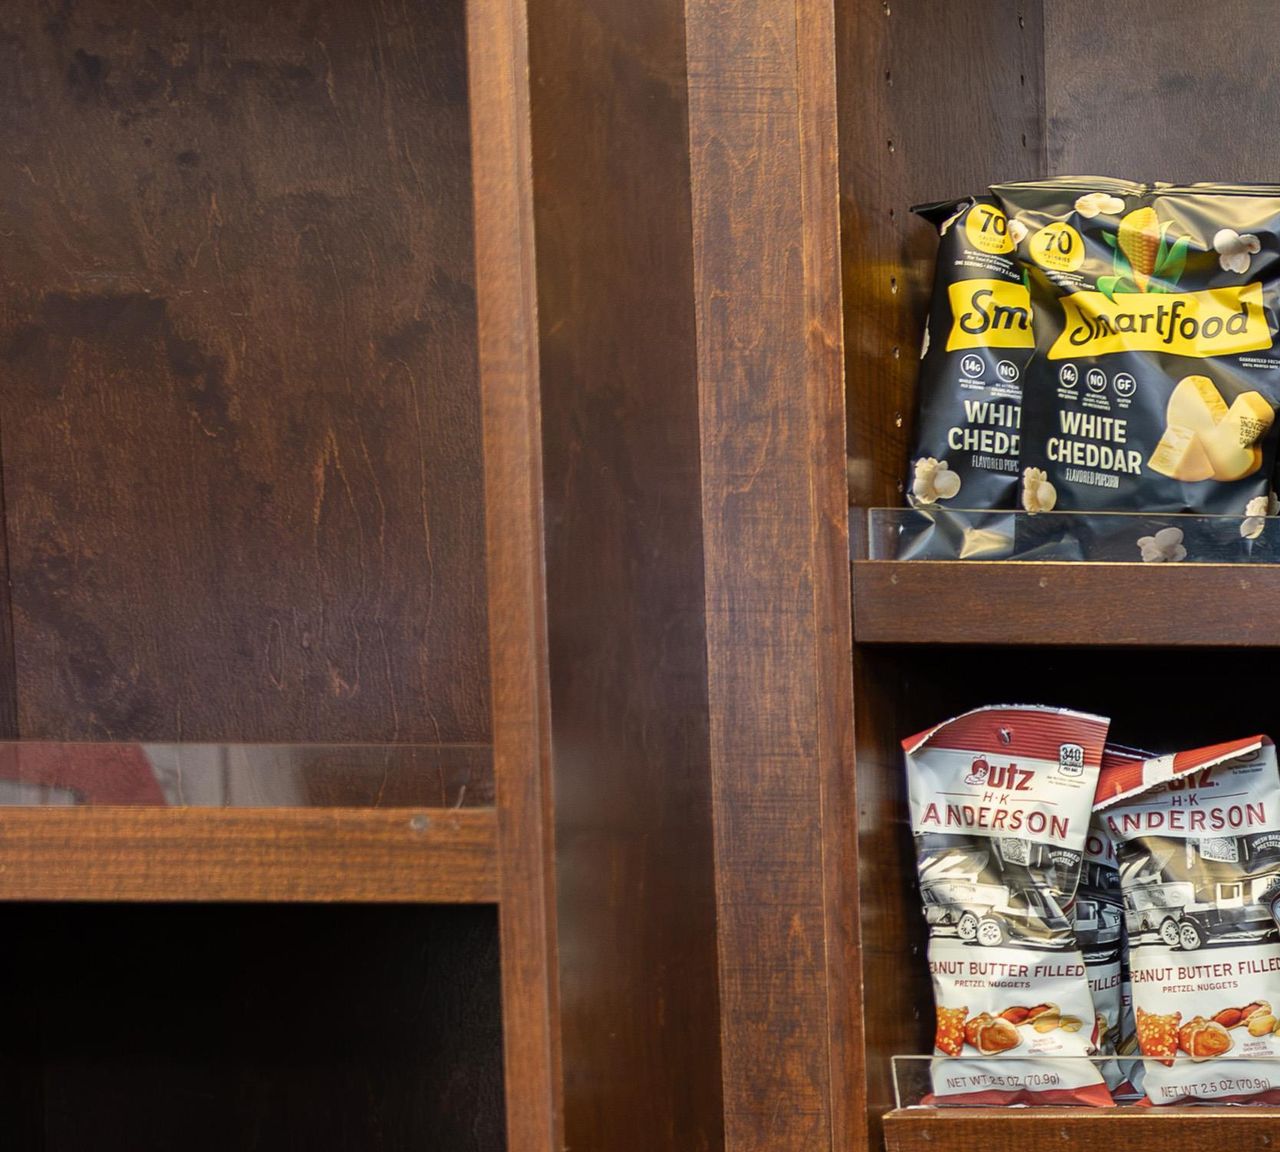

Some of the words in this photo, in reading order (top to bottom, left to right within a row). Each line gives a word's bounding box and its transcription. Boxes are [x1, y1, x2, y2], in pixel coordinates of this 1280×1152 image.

[980, 208, 1007, 236] 70
[1044, 230, 1072, 255] 70
[1069, 300, 1249, 346] Smartfood
[1117, 378, 1132, 391] GF
[1059, 410, 1127, 443] WHITE
[1047, 437, 1142, 475] CHEDDAR
[1062, 746, 1082, 762] 340
[920, 803, 1070, 841] ANDERSON
[1107, 802, 1267, 835] ANDERSON
[970, 962, 1028, 978] BUTTER
[1034, 964, 1085, 978] FILLED
[1130, 966, 1173, 984] PEANUT
[1177, 962, 1234, 980] BUTTER
[954, 979, 986, 988] PRETZEL
[988, 980, 1031, 989] NUGGETS
[1162, 984, 1195, 994] PRETZEL
[1197, 980, 1239, 991] NUGGETS
[947, 1077, 967, 1089] NET
[969, 1076, 988, 1088] WT
[1007, 1074, 1022, 1086] OZ
[1161, 1085, 1179, 1099] NET
[1201, 1082, 1216, 1095] 2.5
[1219, 1081, 1234, 1094] OZ
